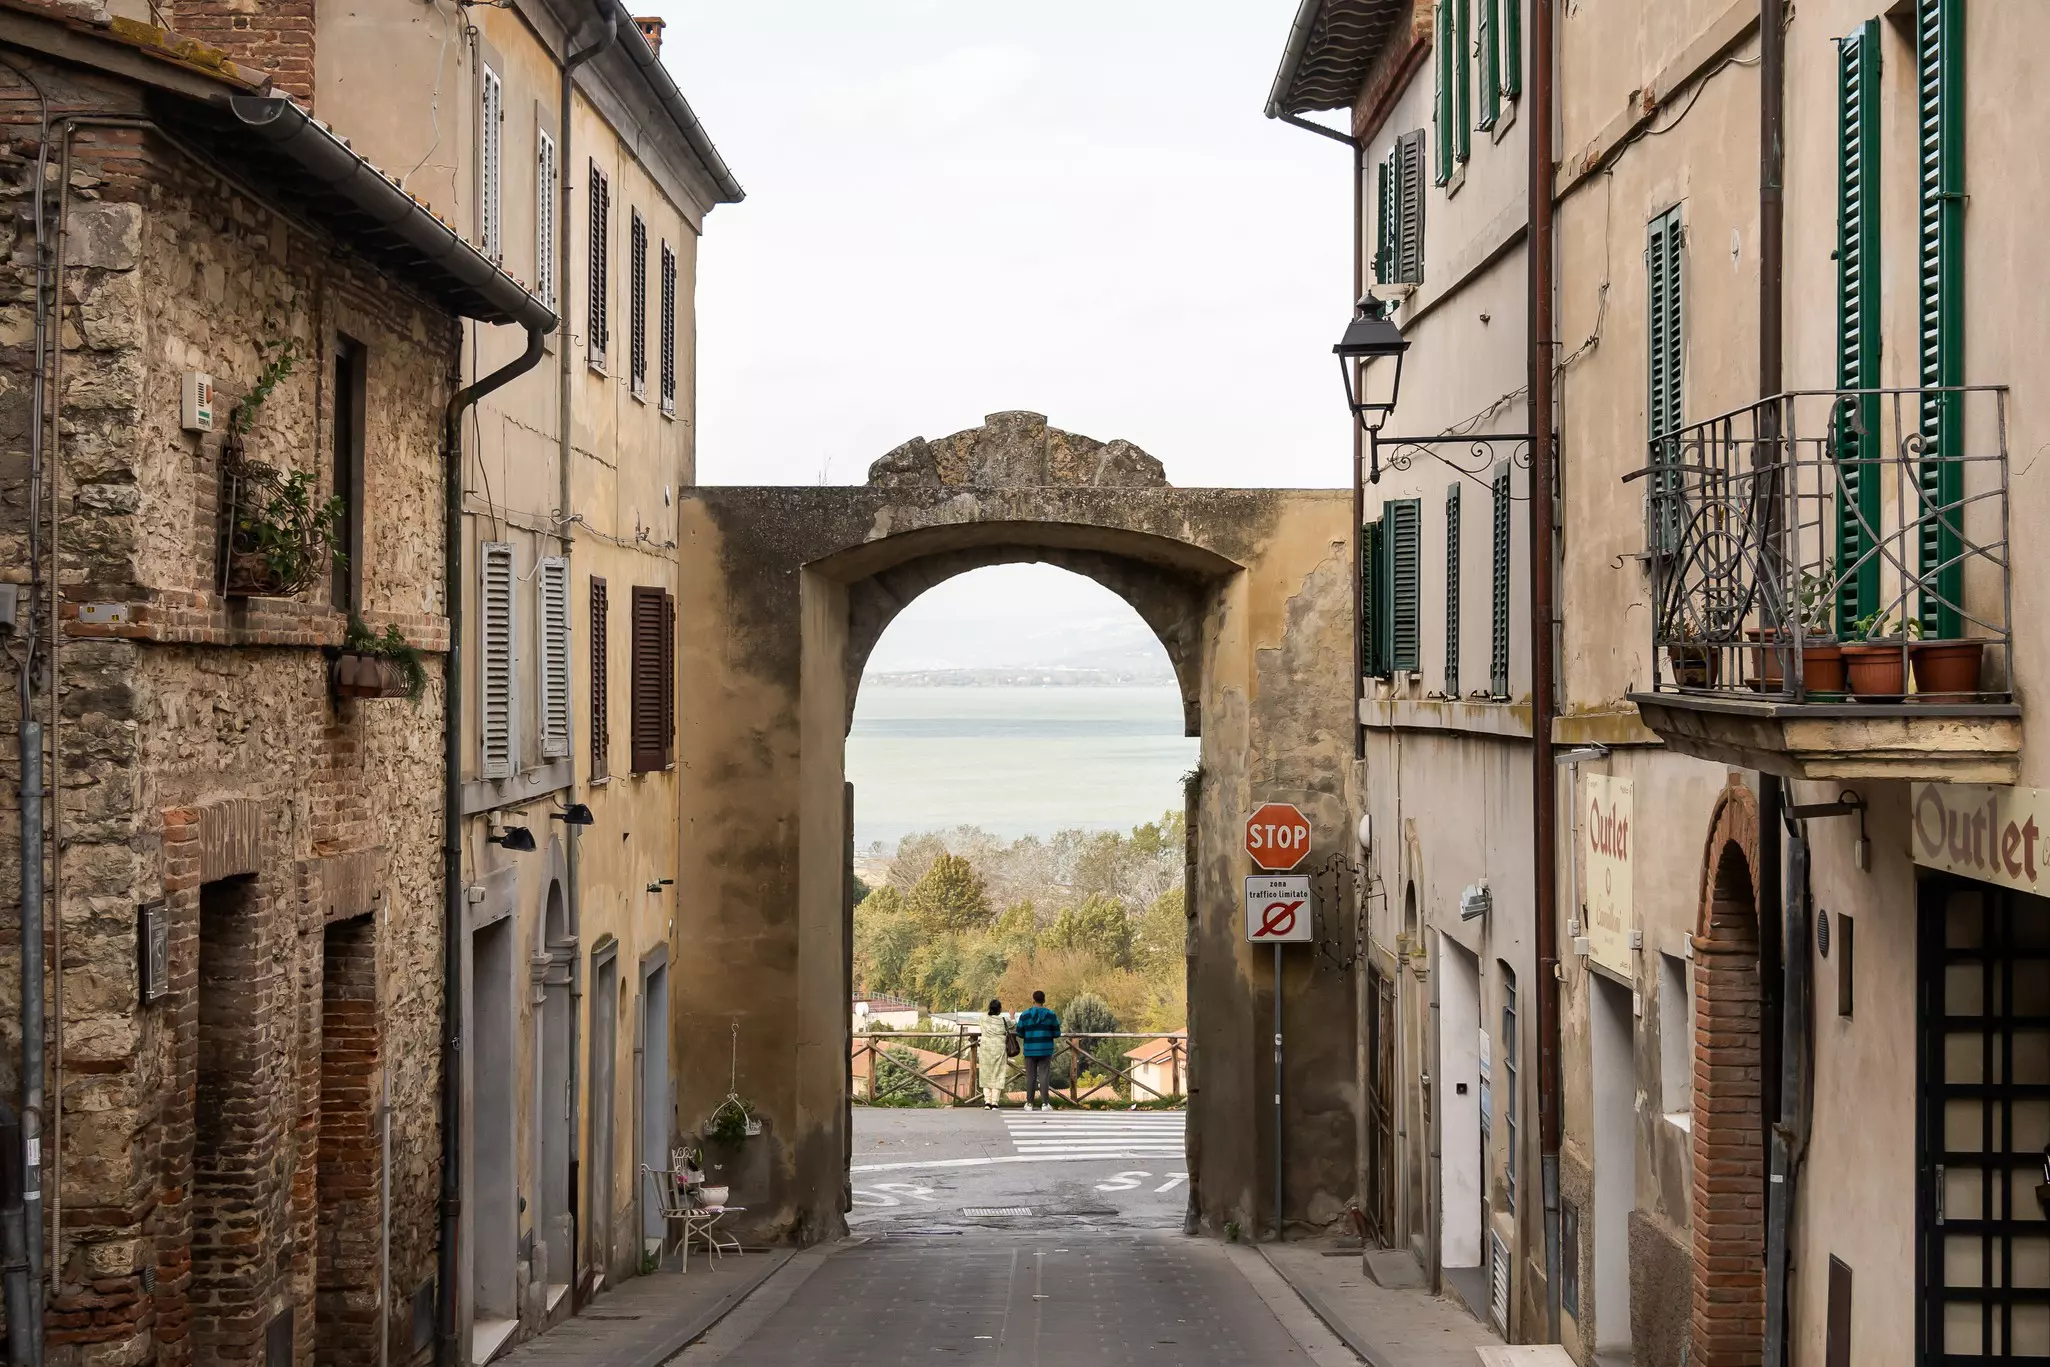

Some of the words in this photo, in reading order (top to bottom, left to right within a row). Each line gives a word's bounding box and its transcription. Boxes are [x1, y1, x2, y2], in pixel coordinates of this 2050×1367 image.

[1249, 823, 1307, 849] STOP
[1589, 796, 1628, 862] Outlet
[1915, 782, 2040, 884] Outlet
[1249, 890, 1277, 899] traffico
[1278, 890, 1308, 898] limitato
[1269, 880, 1287, 888] zona
[1094, 1171, 1190, 1193] ST
